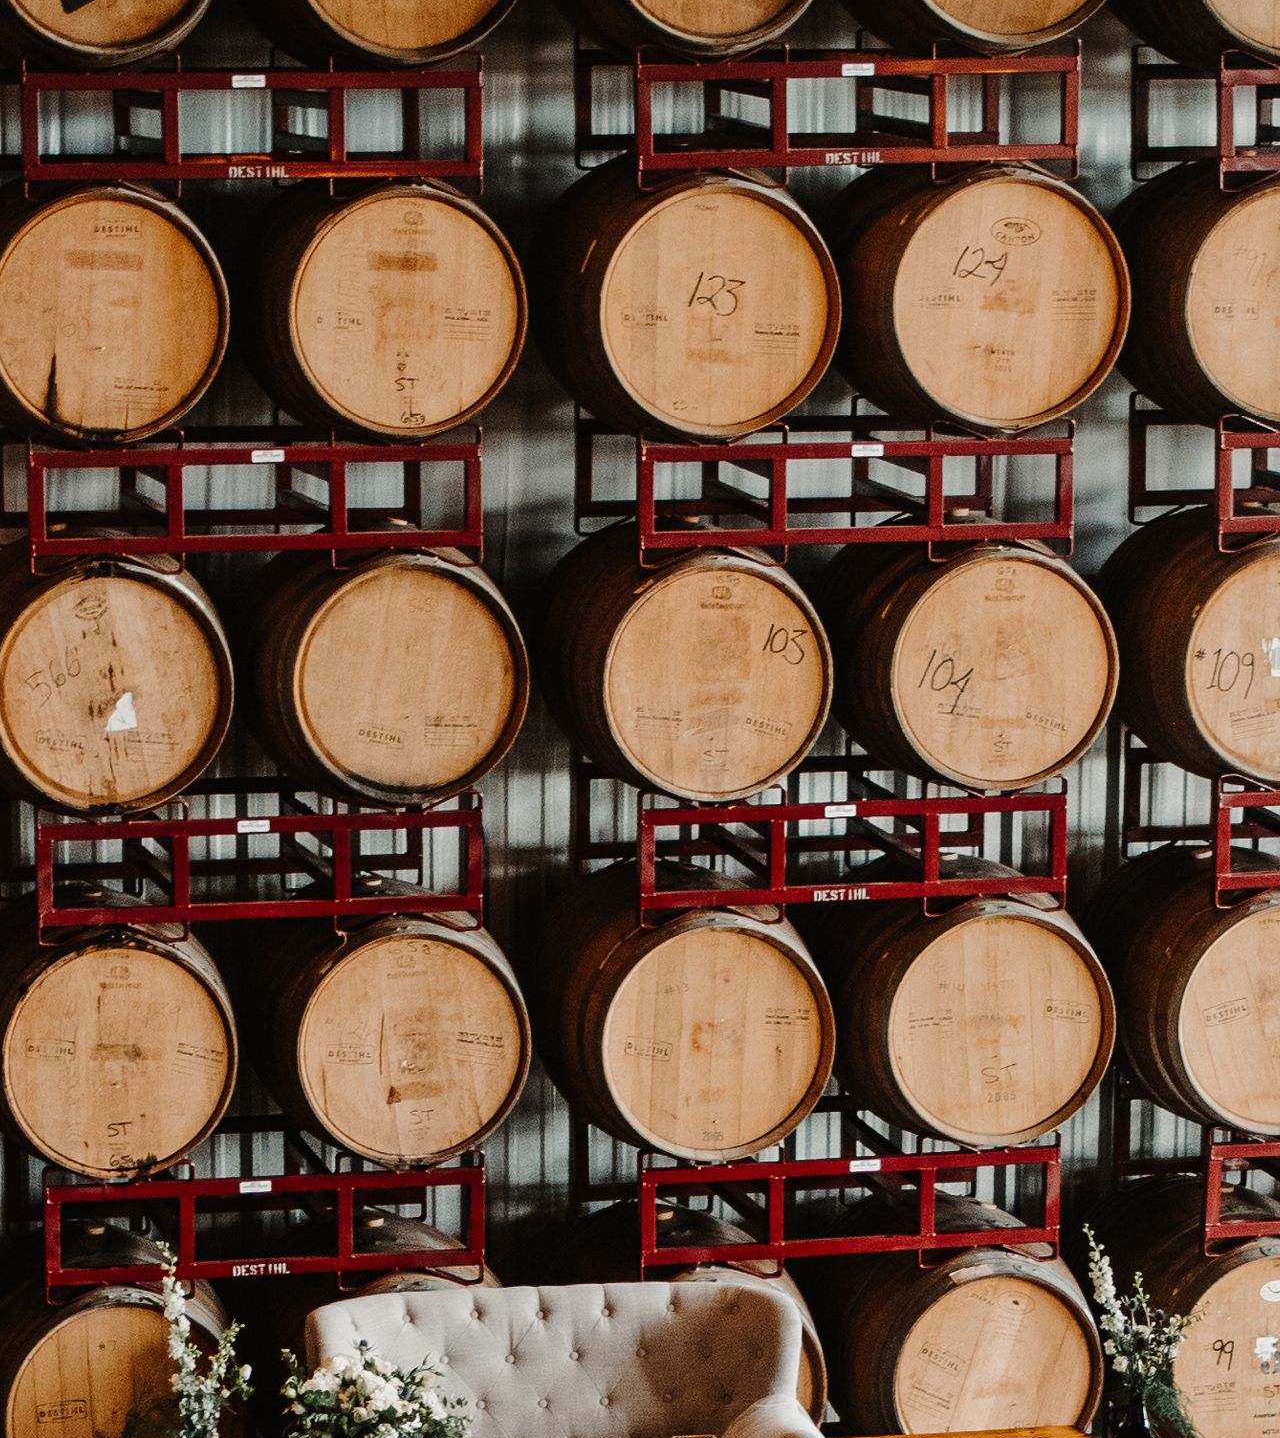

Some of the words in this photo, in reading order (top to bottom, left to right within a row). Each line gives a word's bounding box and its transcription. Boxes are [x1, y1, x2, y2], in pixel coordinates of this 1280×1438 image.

[825, 150, 884, 166] DESTIHL
[228, 165, 289, 179] DESTIHL
[687, 271, 746, 317] 123
[762, 622, 810, 666] 103
[917, 649, 974, 714] 104
[1194, 648, 1255, 699] #109
[745, 716, 788, 737] DESTIHL
[1025, 710, 1067, 733] DESTIHL
[356, 727, 403, 744] DESTIHL
[813, 887, 871, 902] DESTIHL
[1046, 1003, 1088, 1017] DESTIHL
[1205, 1003, 1248, 1023] DESTIHL
[107, 1121, 133, 1138] ST
[231, 1262, 291, 1276] DESTIHL
[921, 1346, 960, 1372] DESTIHL
[37, 1404, 85, 1419] DESTIHL
